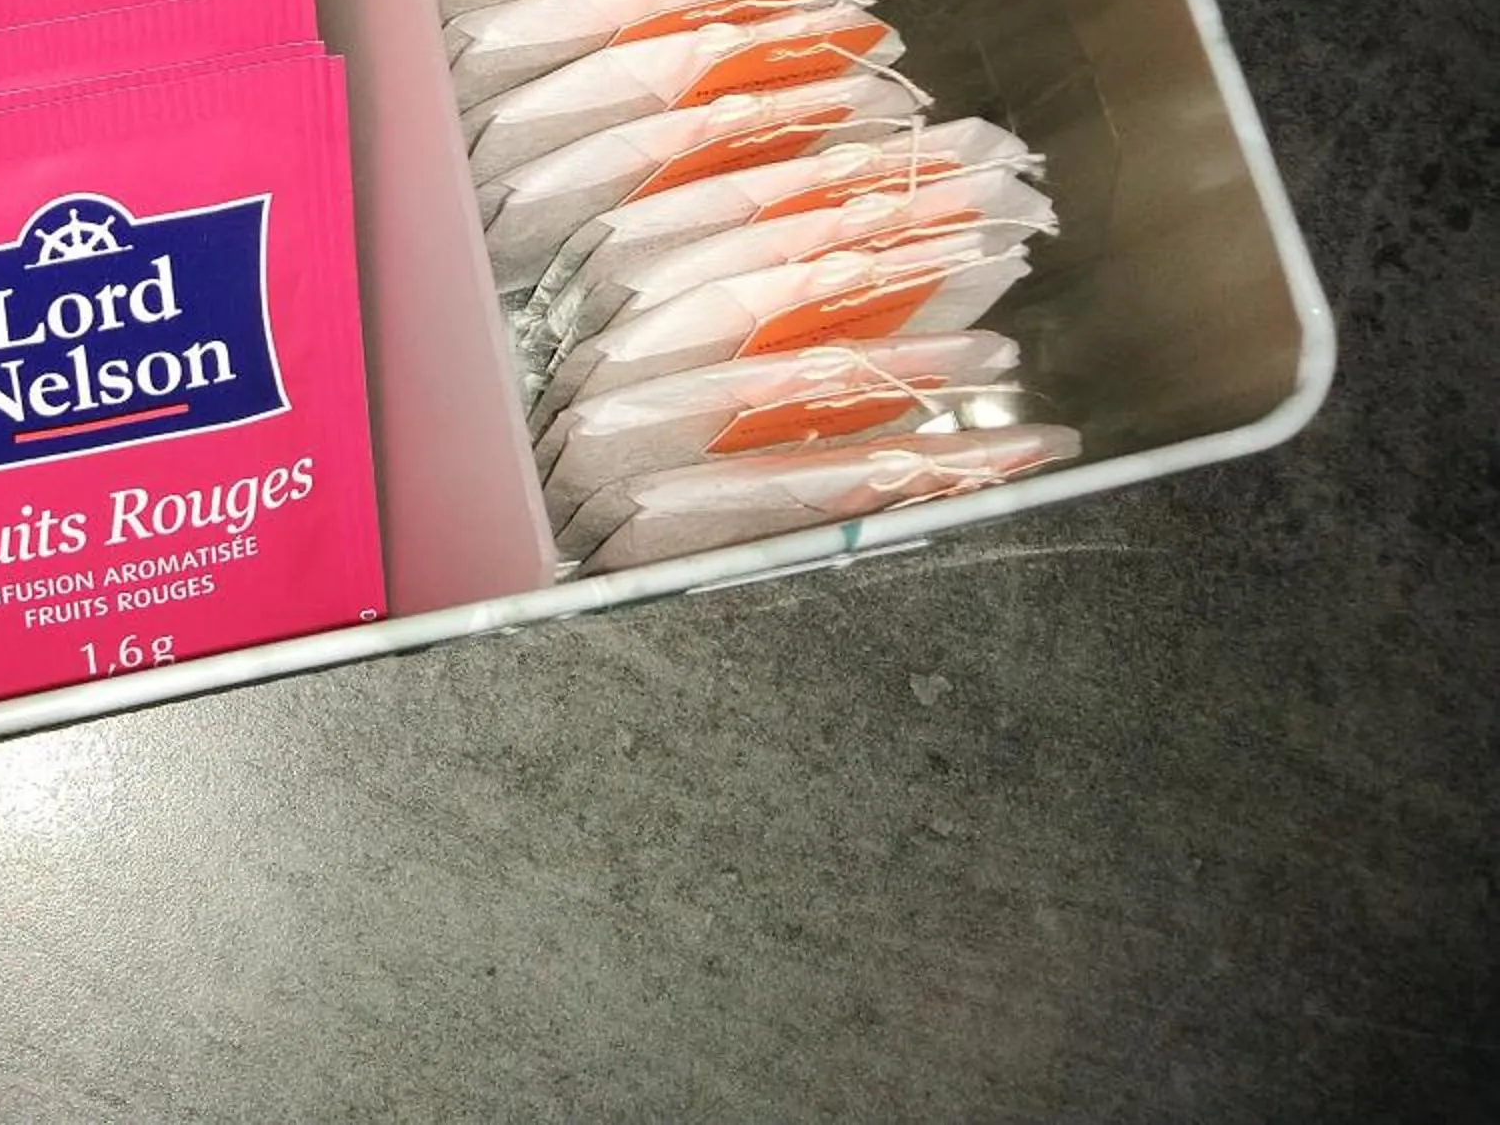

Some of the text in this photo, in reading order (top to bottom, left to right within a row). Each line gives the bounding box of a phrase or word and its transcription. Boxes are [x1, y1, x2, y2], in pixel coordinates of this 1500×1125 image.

[104, 456, 315, 546] Rouges
[104, 534, 260, 586] AROMATISÉE
[24, 575, 216, 628] FRUITS ROUGES
